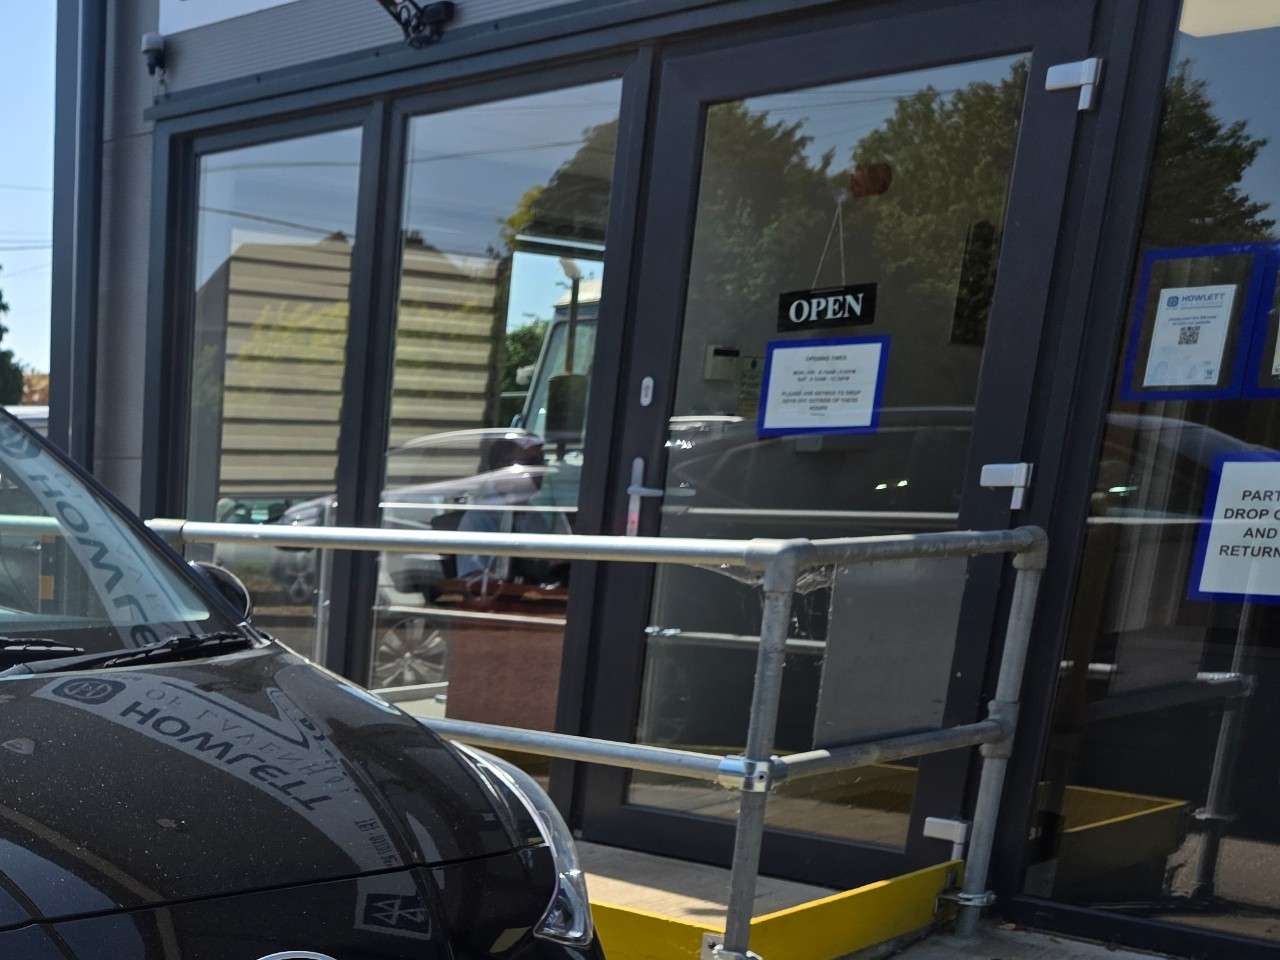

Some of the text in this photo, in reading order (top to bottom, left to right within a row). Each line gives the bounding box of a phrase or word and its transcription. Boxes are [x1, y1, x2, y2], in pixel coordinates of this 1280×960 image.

[1181, 293, 1225, 302] HOWLETT
[789, 293, 864, 323] OPEN
[1224, 508, 1269, 519] DROP
[1243, 527, 1278, 539] AND
